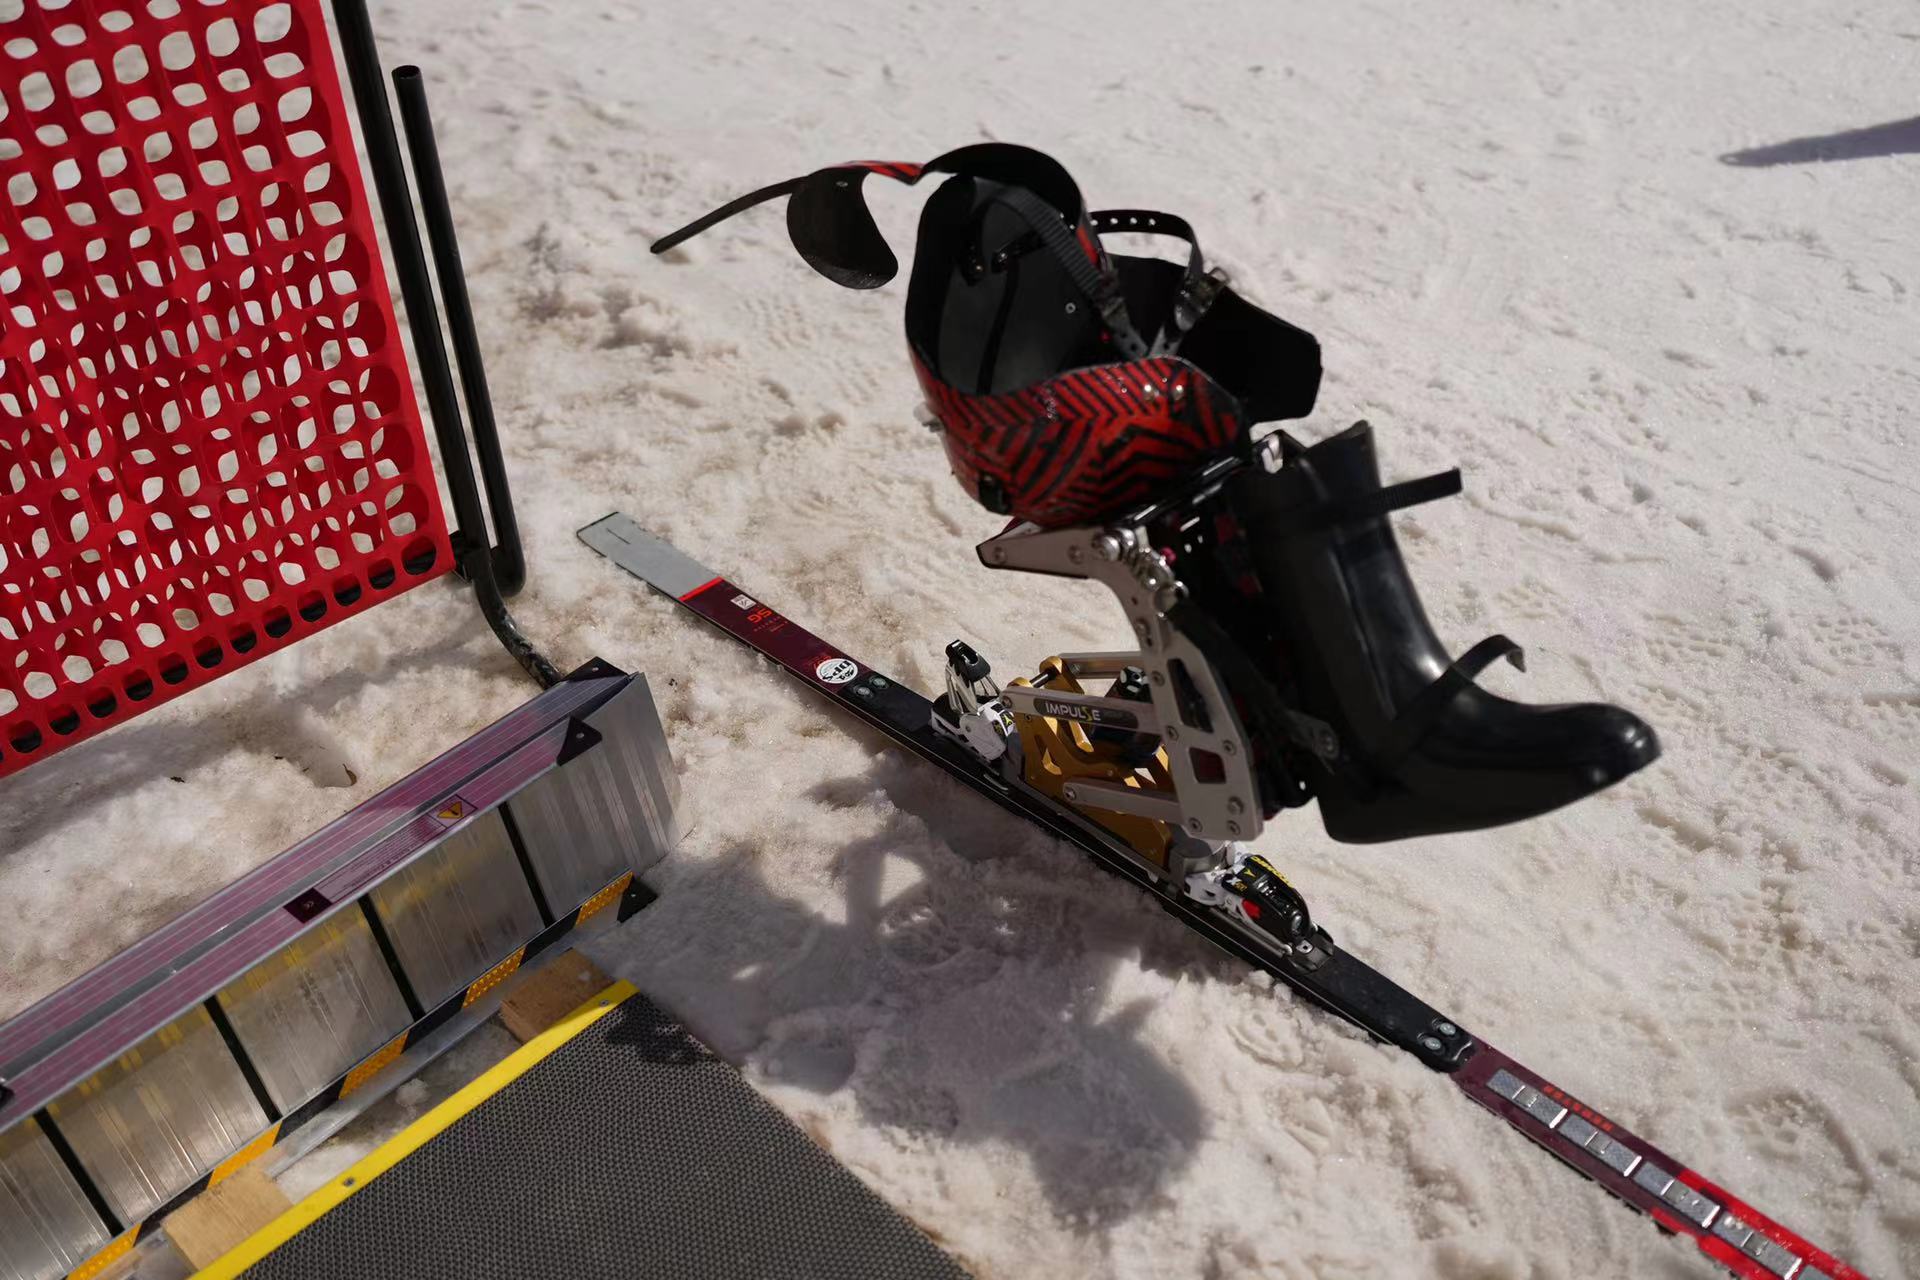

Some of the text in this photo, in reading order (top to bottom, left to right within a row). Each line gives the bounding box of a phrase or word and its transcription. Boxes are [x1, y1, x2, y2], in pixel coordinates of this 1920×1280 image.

[747, 608, 772, 623] SG
[822, 660, 852, 681] DPS
[1045, 701, 1101, 721] IMPULSE
